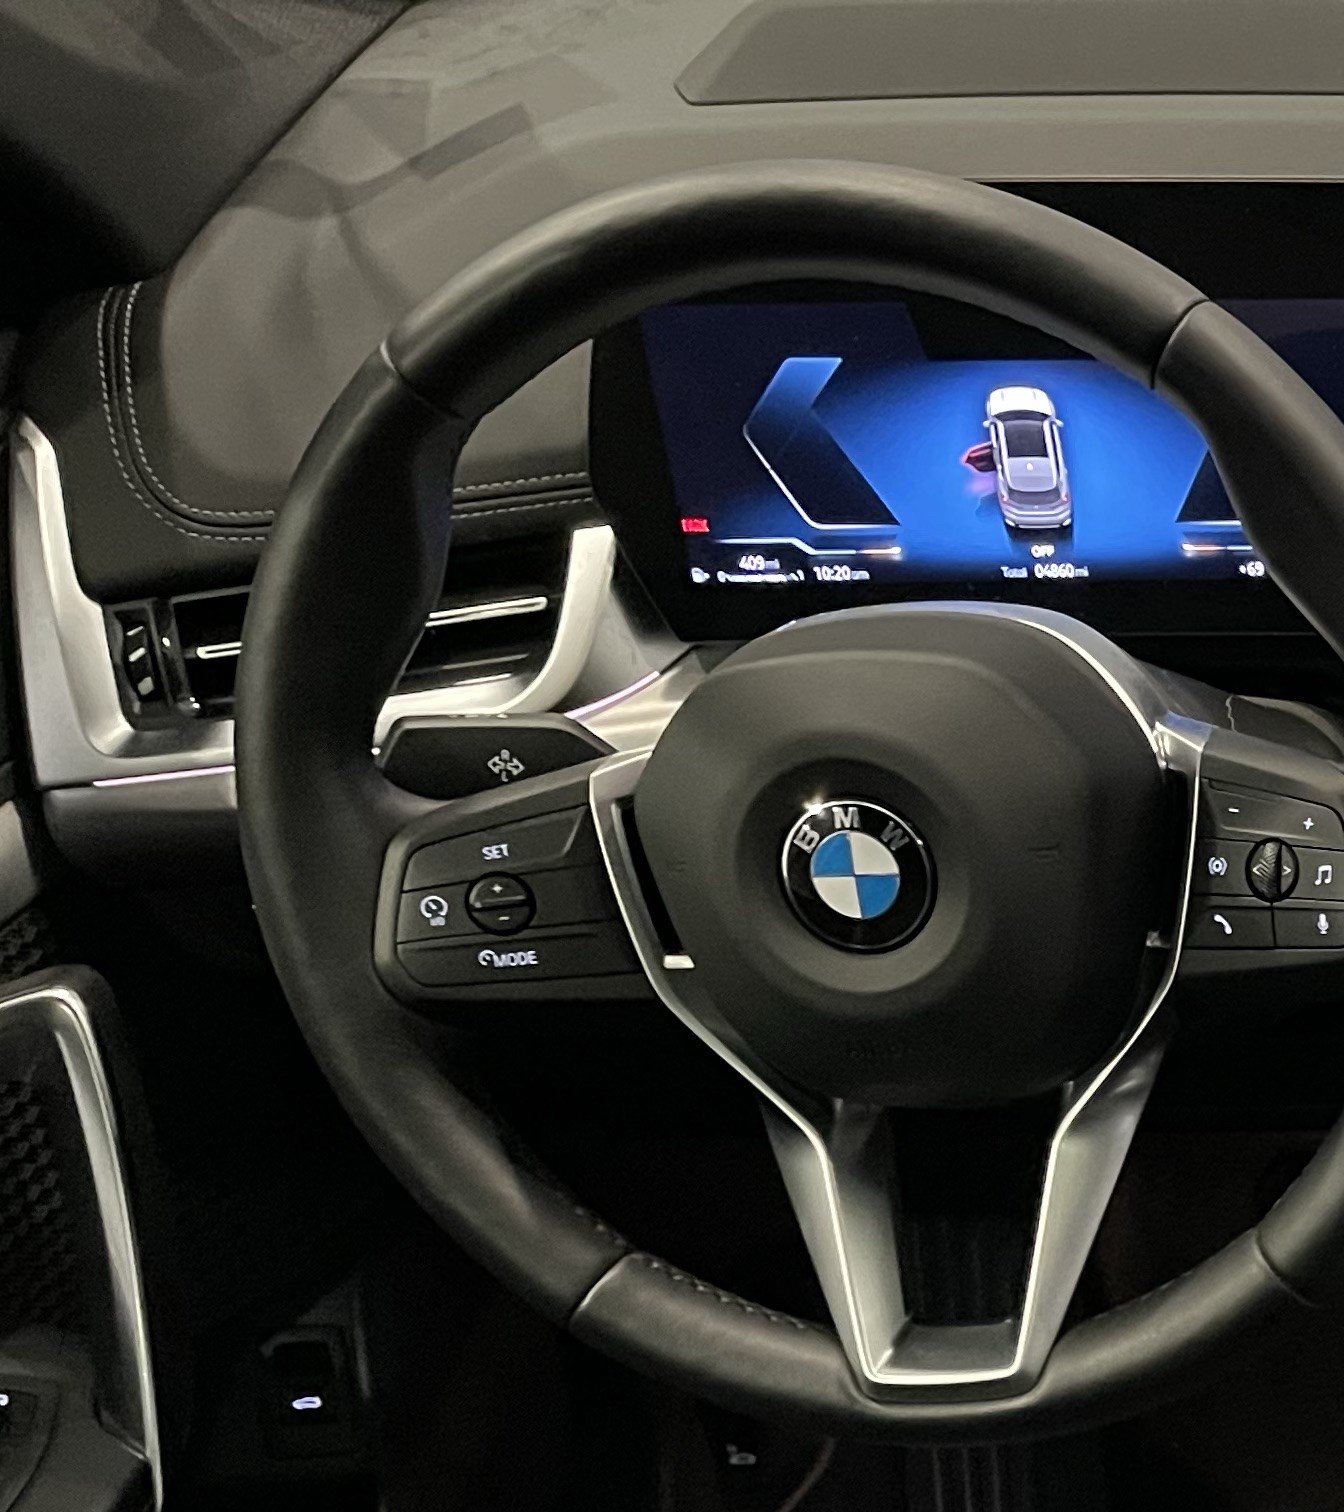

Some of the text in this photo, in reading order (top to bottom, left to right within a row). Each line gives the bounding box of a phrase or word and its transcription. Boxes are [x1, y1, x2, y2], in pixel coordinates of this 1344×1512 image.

[813, 565, 850, 581] 10:20
[793, 806, 910, 853] BMW
[481, 843, 509, 860] SET
[494, 950, 539, 968] MODE
